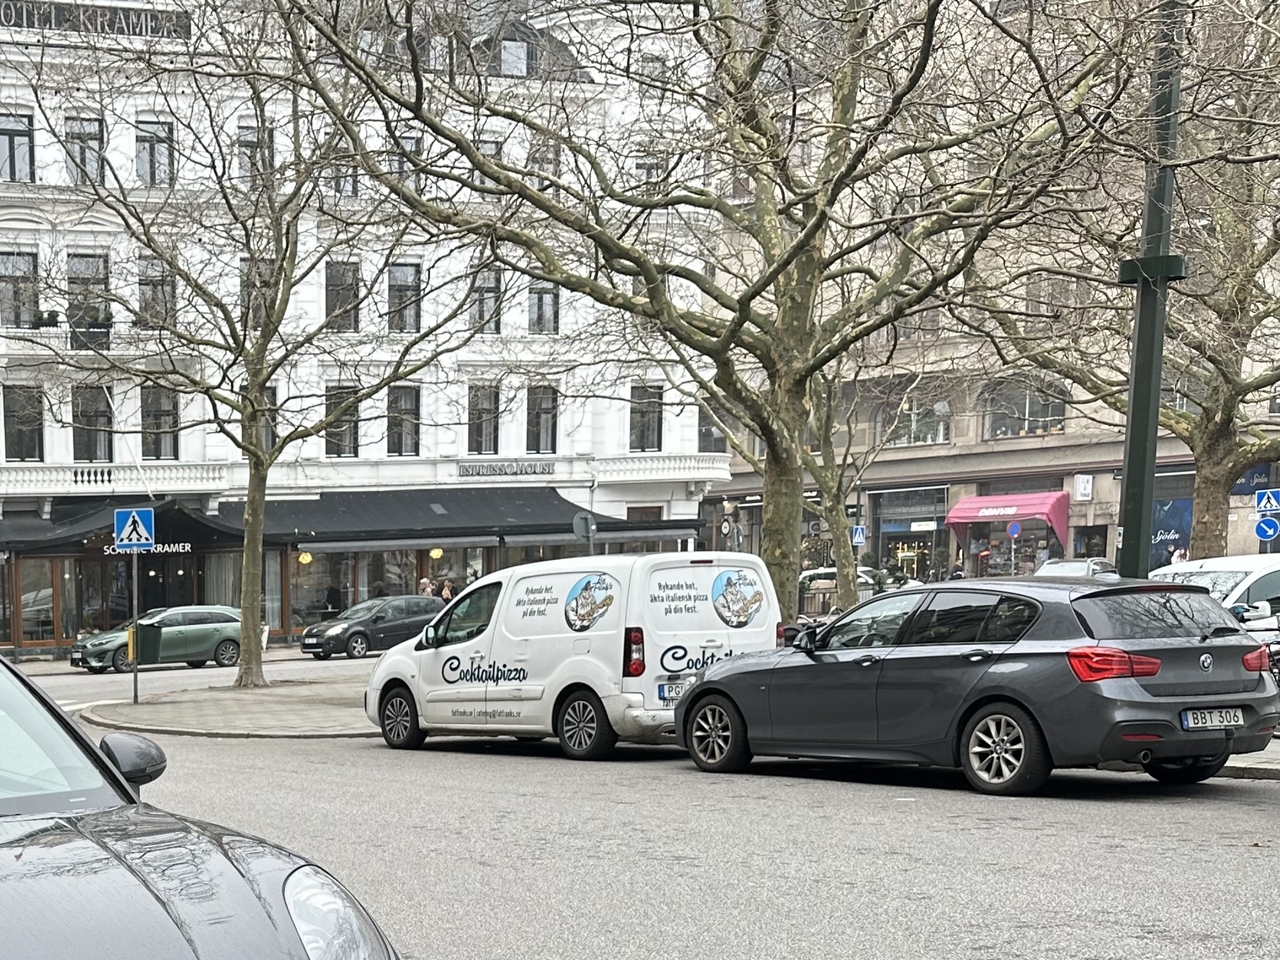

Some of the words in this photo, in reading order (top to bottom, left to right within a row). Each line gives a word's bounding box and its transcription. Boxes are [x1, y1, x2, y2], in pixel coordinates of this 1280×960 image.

[79, 6, 177, 38] KRAMER
[460, 463, 514, 476] ESPRESSO
[517, 462, 555, 475] HOUSE
[1151, 529, 1180, 544] Sjölin
[151, 543, 191, 553] KRAMER
[657, 581, 684, 593] Rykande
[545, 596, 559, 606] pizza
[650, 594, 664, 603] äkta
[665, 593, 692, 603] italiensk
[693, 593, 708, 602] pizza
[528, 607, 536, 617] din
[664, 604, 672, 616] på
[673, 604, 683, 614] din
[441, 655, 528, 686] Cocktailpizza
[1192, 711, 1213, 725] BBT
[1218, 710, 1240, 723] 306
